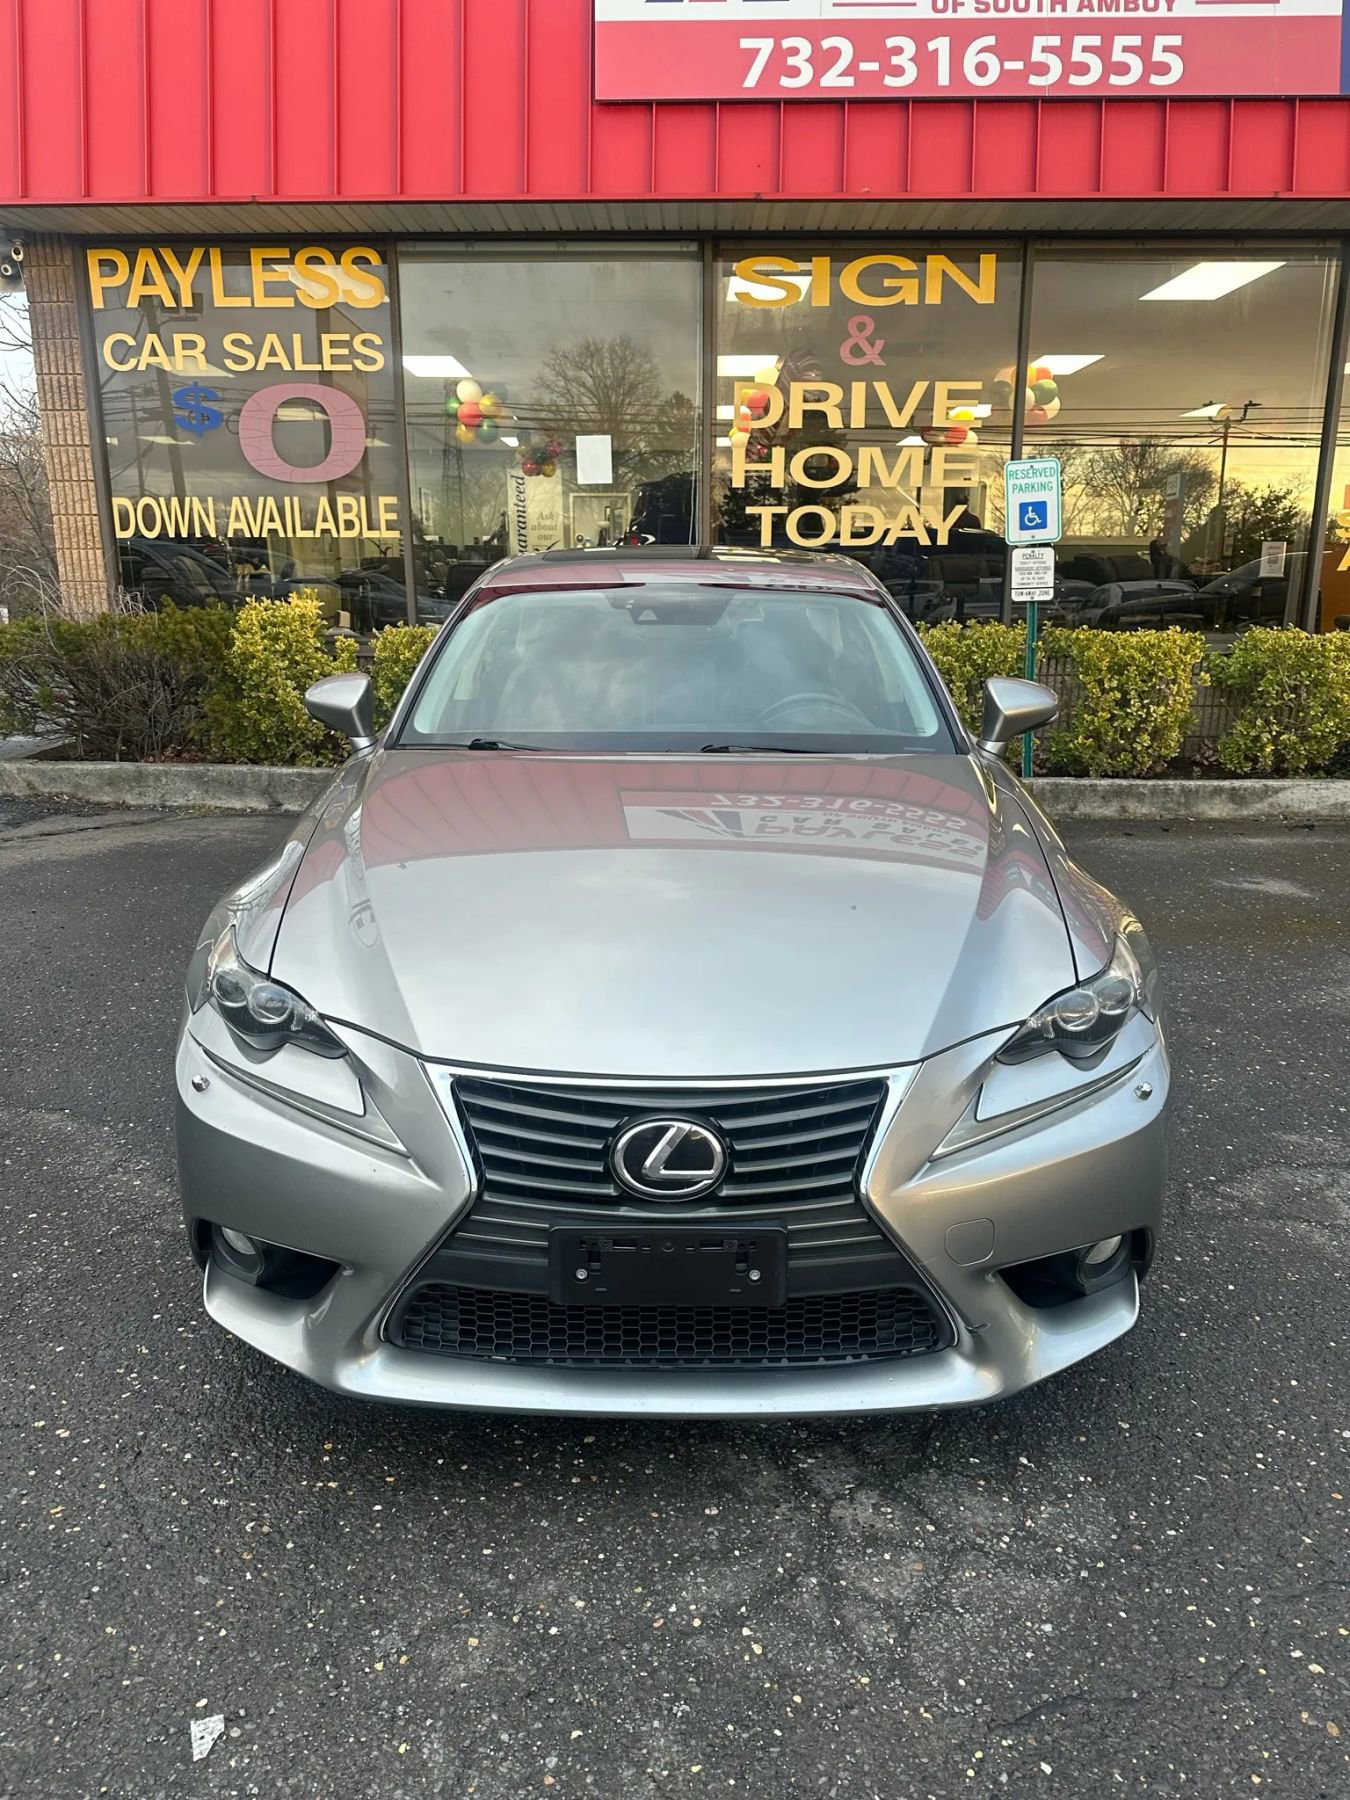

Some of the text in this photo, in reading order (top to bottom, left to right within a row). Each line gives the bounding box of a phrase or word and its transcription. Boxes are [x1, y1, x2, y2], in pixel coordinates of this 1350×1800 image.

[931, 0, 1176, 14] OF SOUTH AMBOY
[739, 35, 1184, 88] 732-316-5555
[87, 247, 386, 309] PAYLESS
[734, 254, 997, 309] SIGN
[103, 333, 385, 371] CAR SALES
[839, 315, 887, 366] &
[733, 381, 984, 429] DRIVE
[731, 446, 980, 488] HOME
[1008, 467, 1056, 480] RESERVED
[1012, 481, 1053, 494] PARKING
[112, 496, 401, 539] DOWN AVAILABLE
[530, 521, 558, 531] about
[745, 504, 968, 547] TODAY
